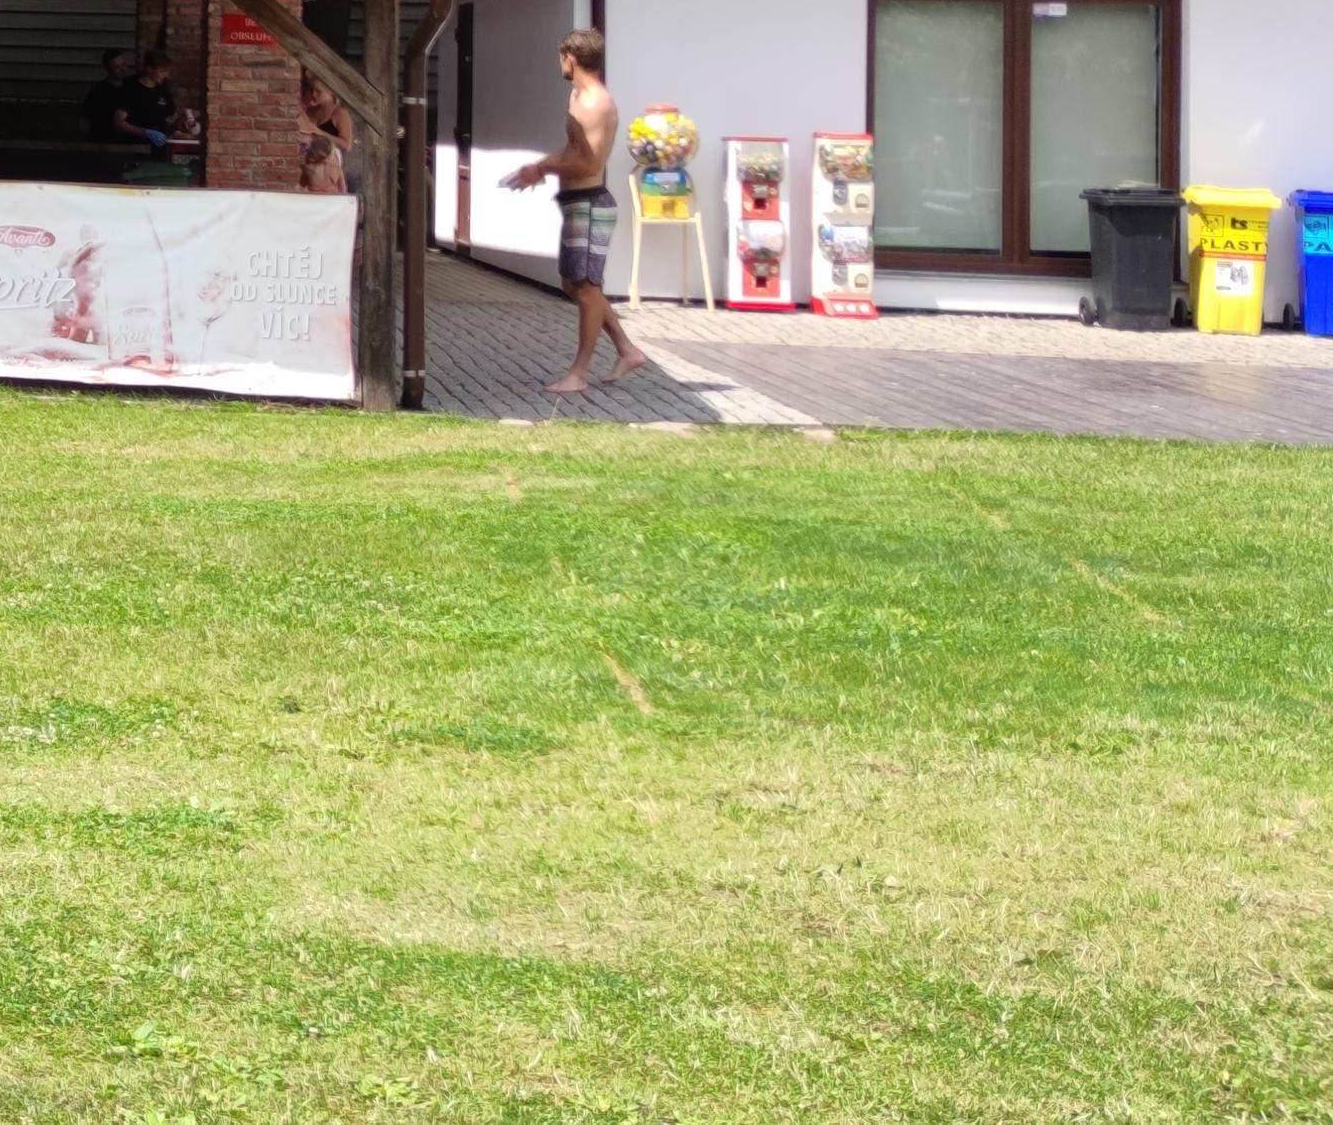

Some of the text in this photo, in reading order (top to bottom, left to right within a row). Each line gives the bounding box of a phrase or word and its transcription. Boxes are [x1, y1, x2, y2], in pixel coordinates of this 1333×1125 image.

[245, 18, 259, 27] BE
[1200, 237, 1269, 252] PLAST
[247, 243, 324, 280] CHTĚJ
[230, 282, 338, 306] OD SLUNCE
[260, 306, 310, 341] VÍC!
